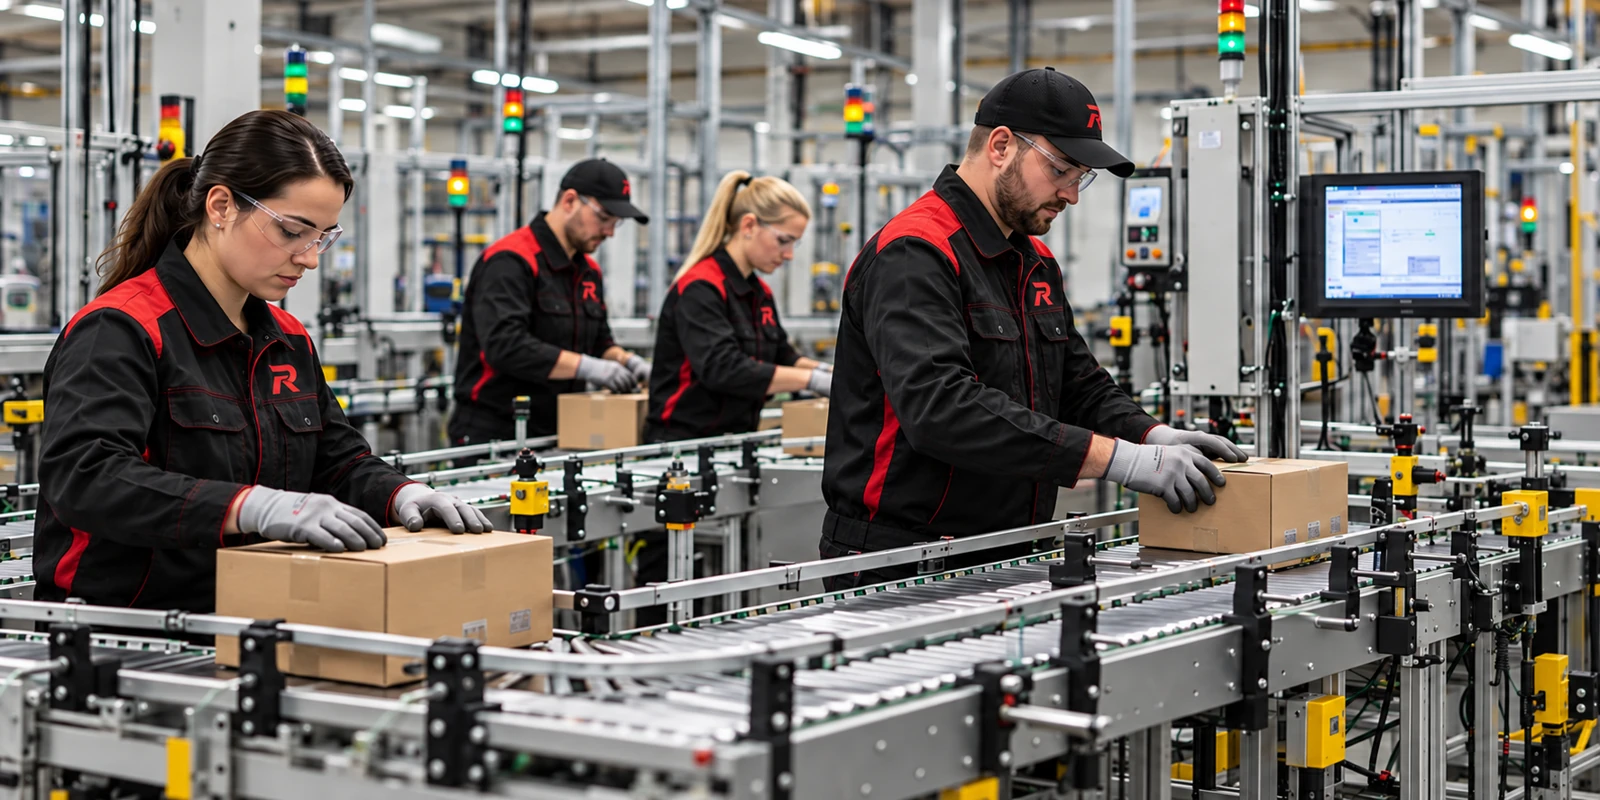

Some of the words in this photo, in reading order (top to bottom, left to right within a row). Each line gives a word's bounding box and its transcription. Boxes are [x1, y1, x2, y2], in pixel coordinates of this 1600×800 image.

[582, 281, 599, 302] R
[1032, 282, 1053, 306] R
[760, 307, 776, 325] R
[269, 364, 300, 395] R
